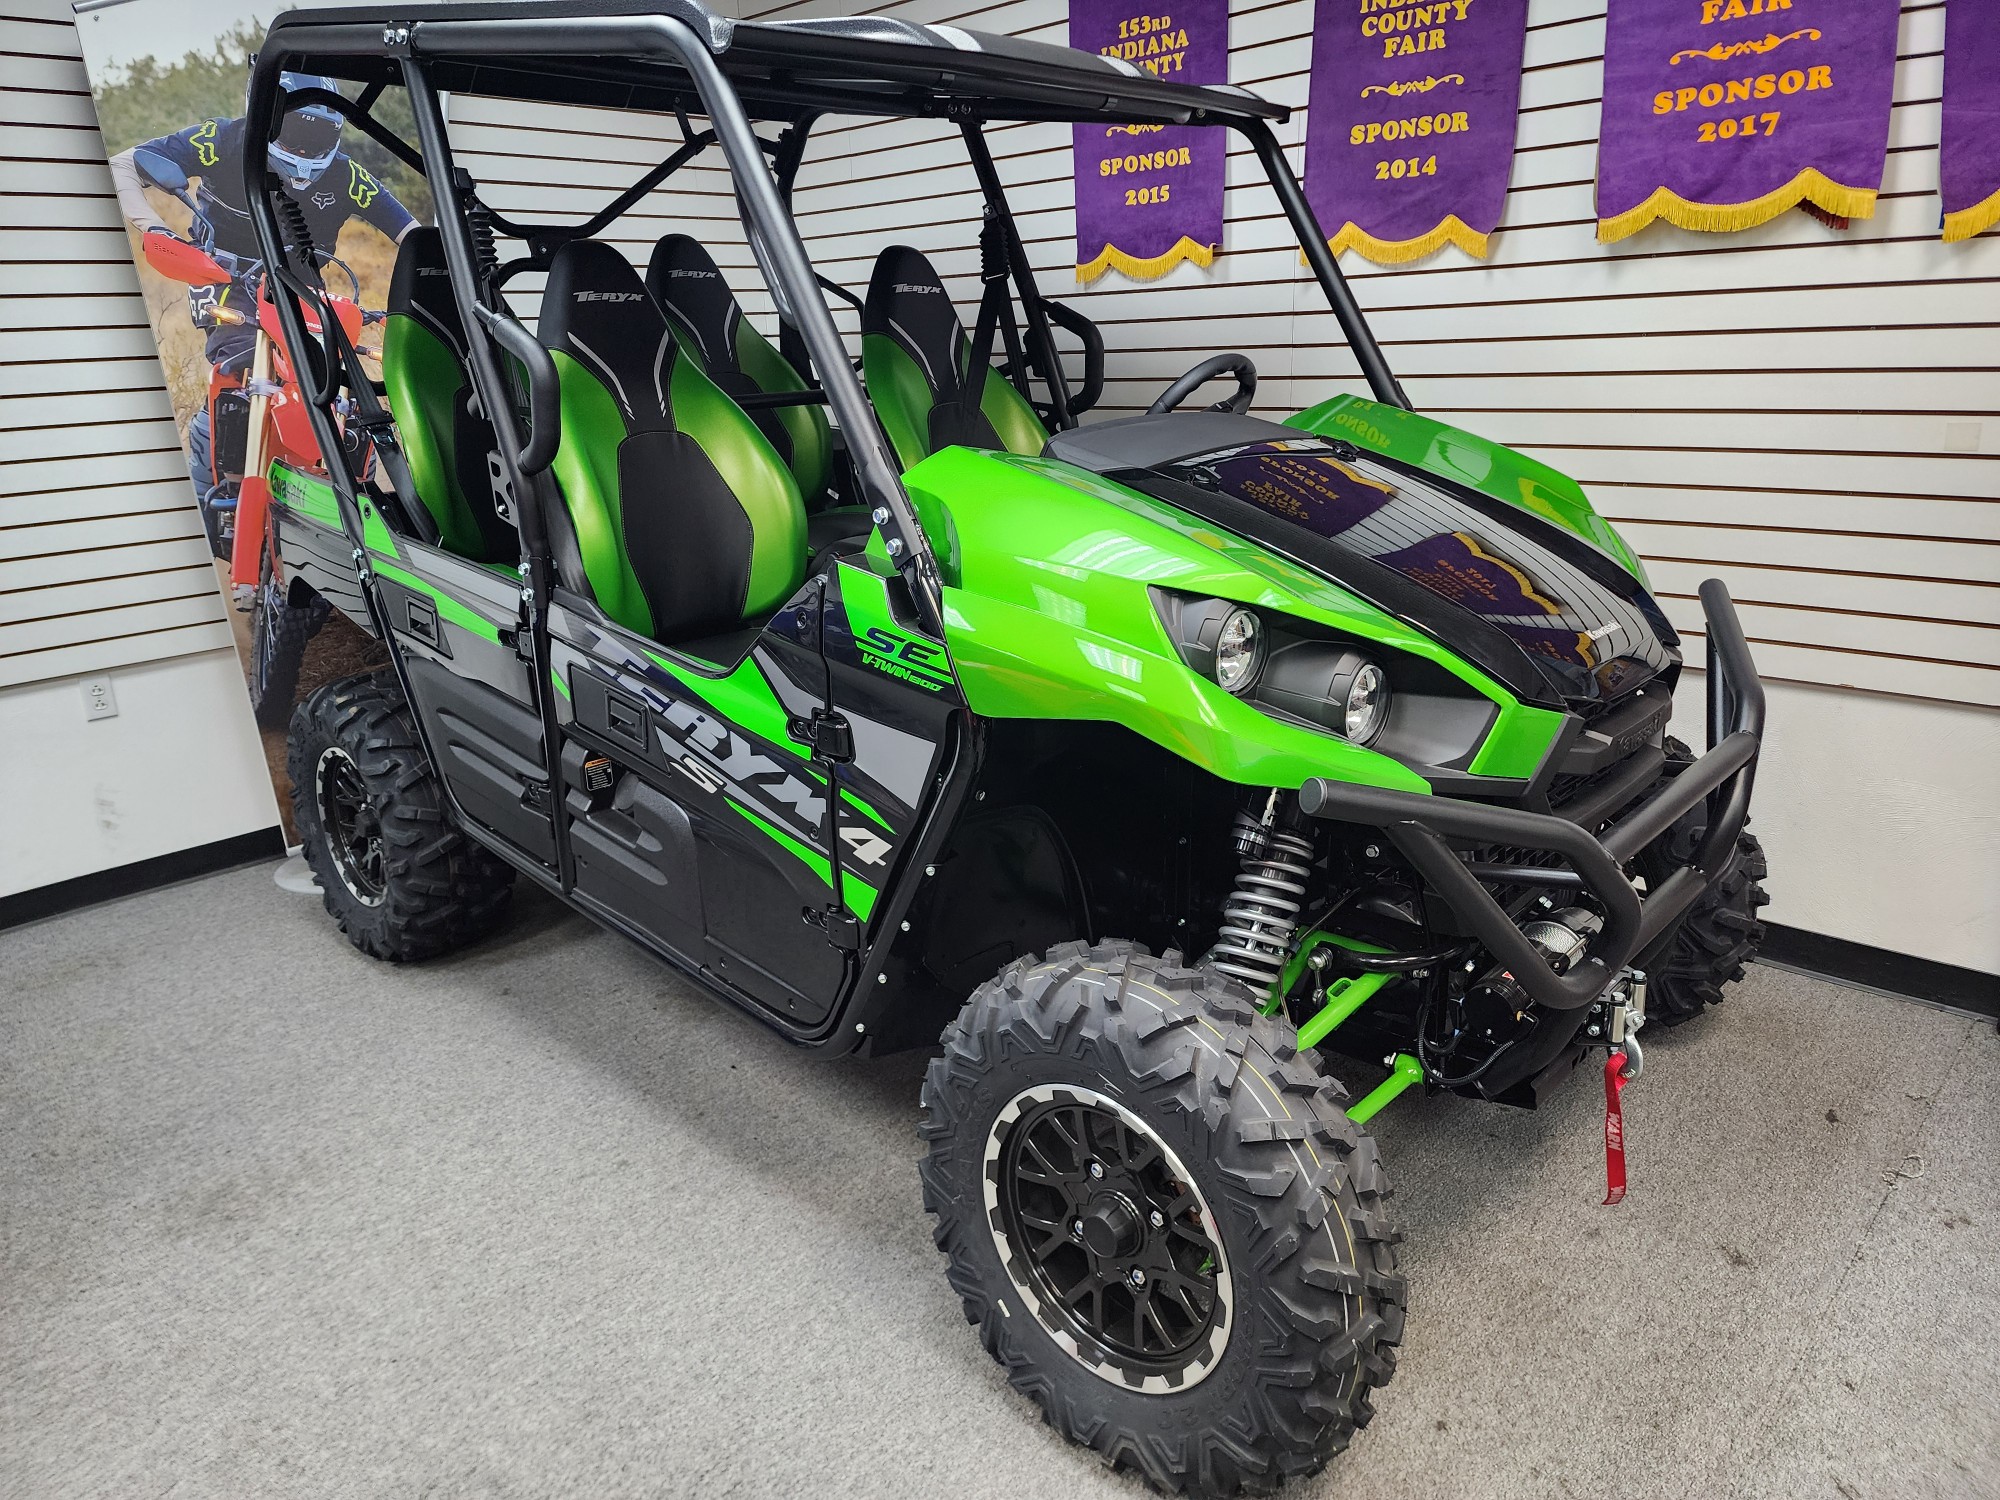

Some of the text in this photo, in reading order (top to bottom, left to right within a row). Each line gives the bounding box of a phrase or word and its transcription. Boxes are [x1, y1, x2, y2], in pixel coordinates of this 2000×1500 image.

[1118, 15, 1171, 39] 153RD
[1361, 0, 1474, 37] COUNTY
[1383, 28, 1446, 58] FAIR
[1651, 65, 1834, 115] SPONSOR
[301, 114, 316, 122] FOX
[1349, 112, 1470, 145] SPONSOR
[1696, 111, 1781, 143] 2017
[1100, 147, 1192, 177] SPONSOR
[1375, 155, 1437, 180] 2014
[1125, 184, 1170, 206] 2015
[572, 290, 645, 303] TERYX
[1584, 620, 1623, 641] Kawasaki
[861, 627, 945, 671] SE
[839, 827, 893, 867] 4
[1607, 1112, 1622, 1151] WARN
